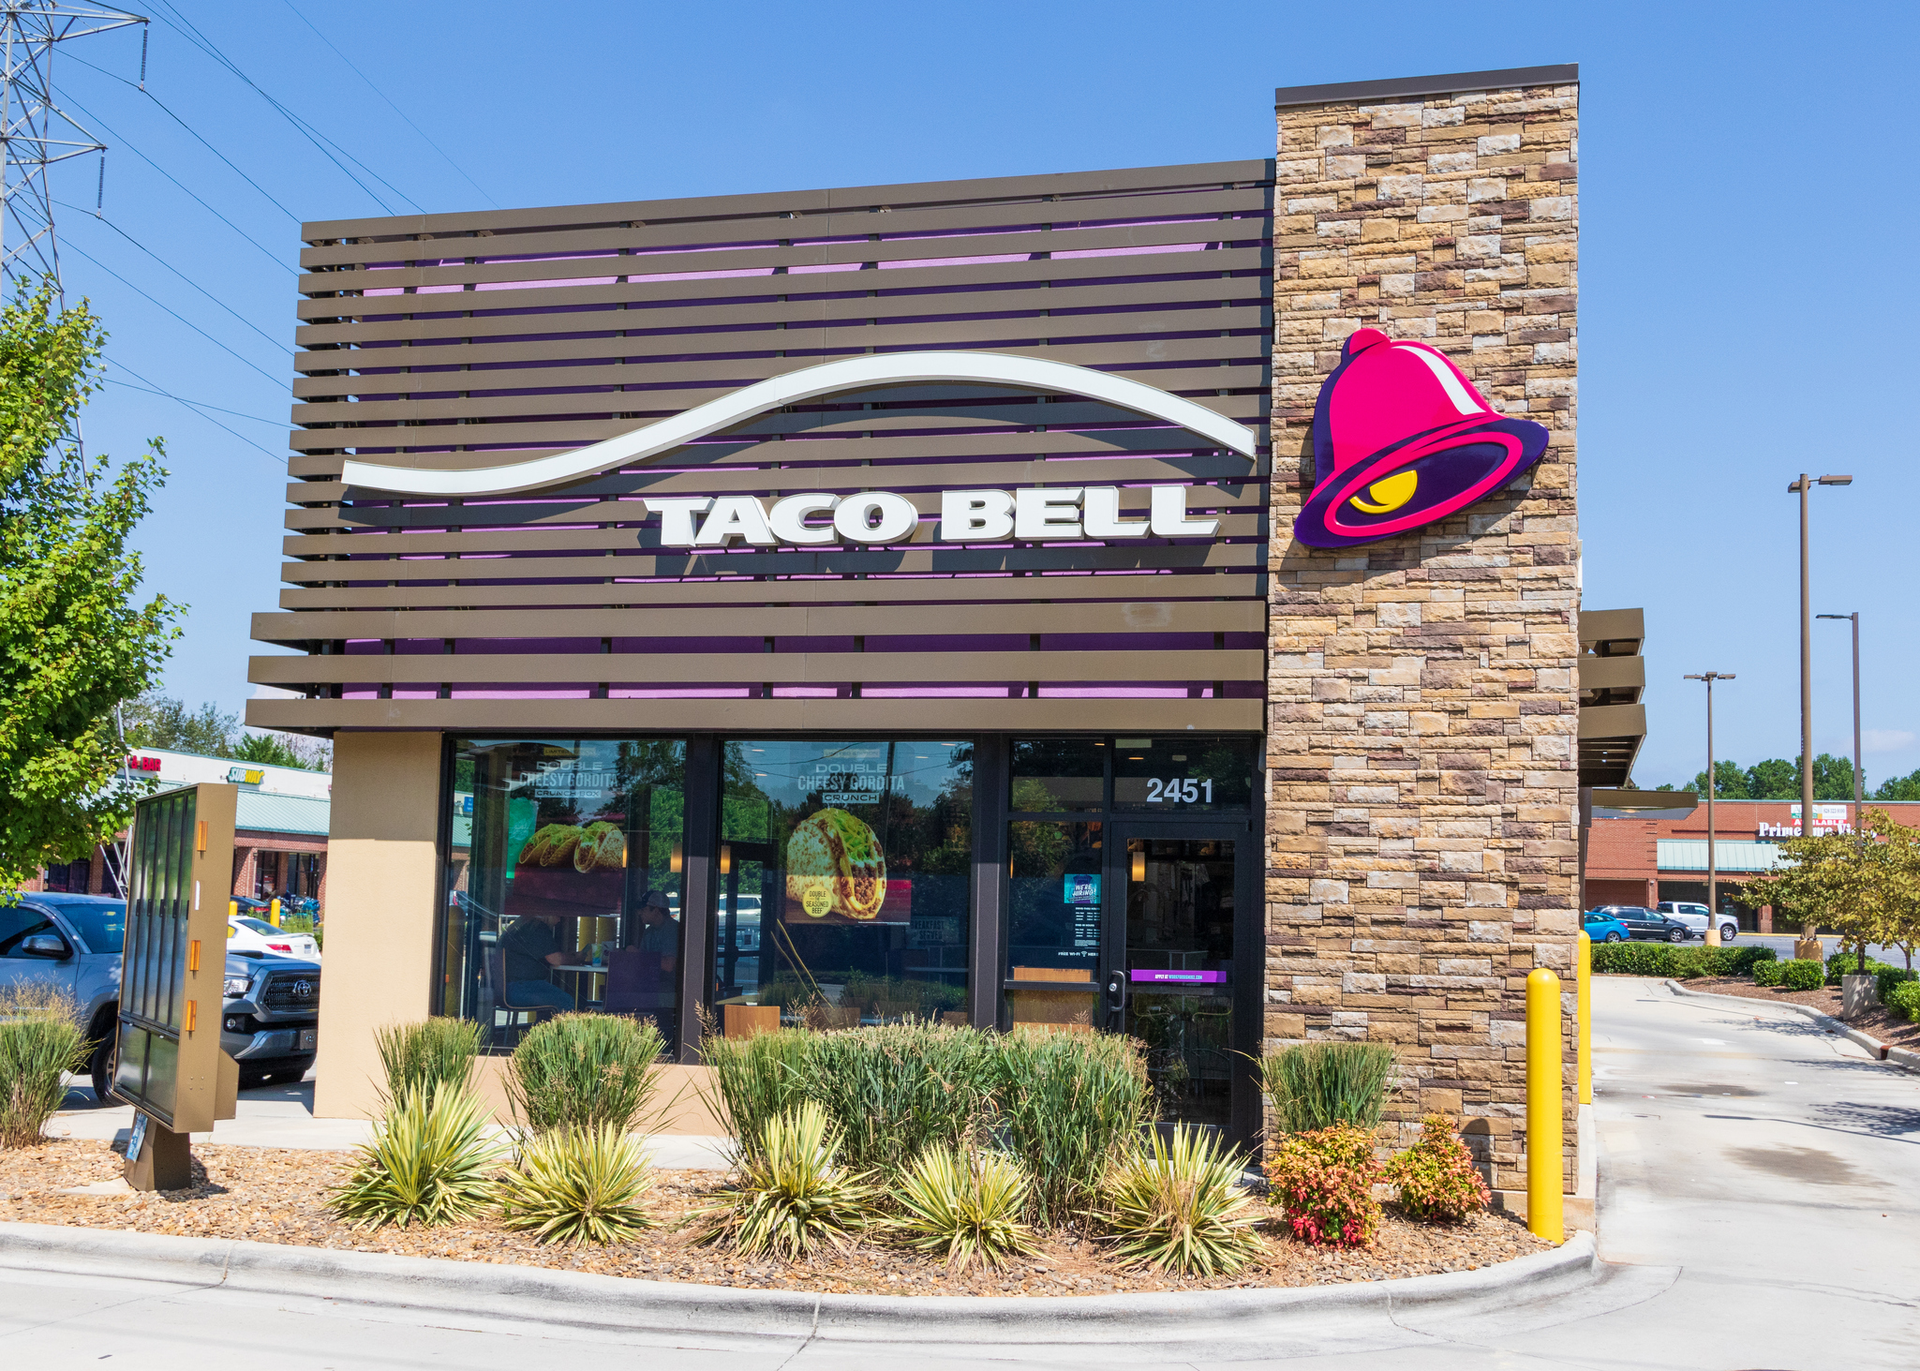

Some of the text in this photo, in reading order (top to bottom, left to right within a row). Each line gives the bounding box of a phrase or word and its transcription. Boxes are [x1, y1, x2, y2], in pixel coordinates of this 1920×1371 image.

[643, 485, 1220, 547] TACO BELL
[131, 755, 161, 771] & BAR
[536, 761, 603, 770] DOUBLE
[816, 764, 887, 773] DOUBLE
[229, 768, 265, 785] SUBWAY
[520, 772, 618, 787] CHEESY GORDITA
[798, 775, 905, 791] CHEESY GORDITA
[1147, 778, 1212, 803] 2451
